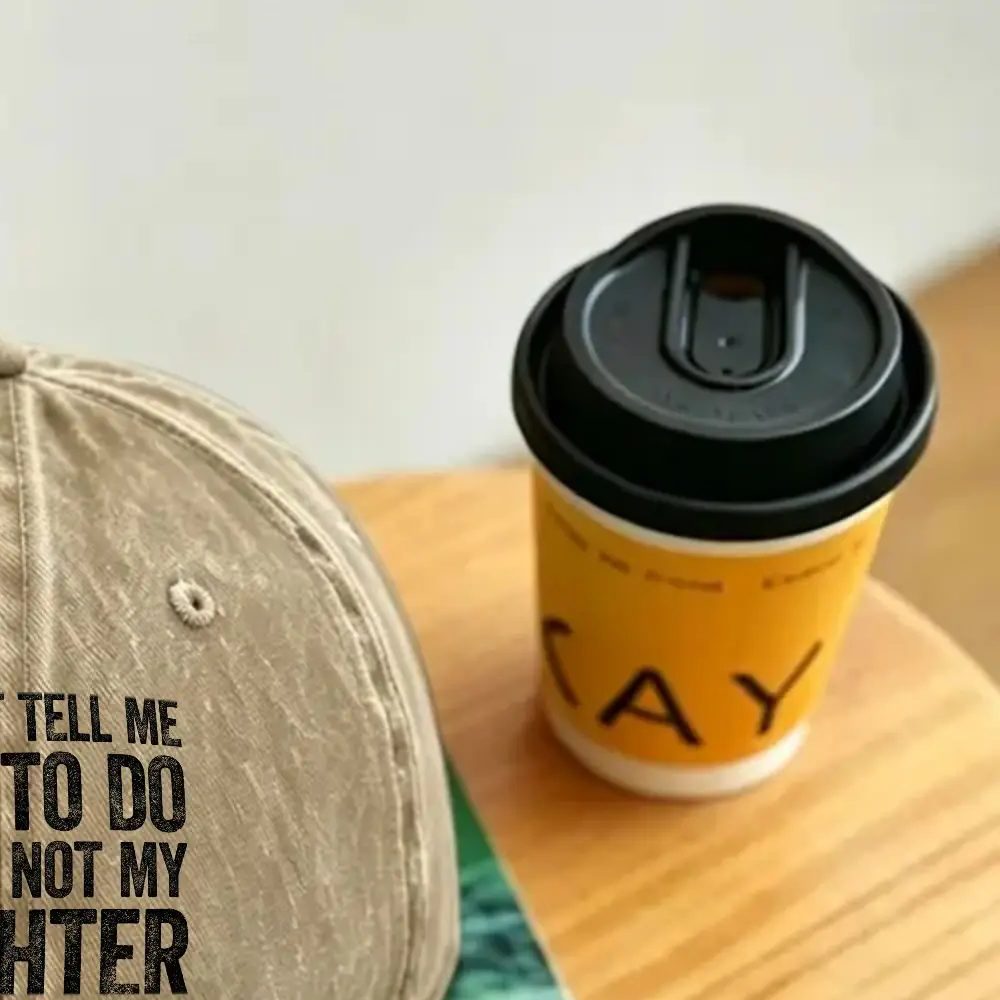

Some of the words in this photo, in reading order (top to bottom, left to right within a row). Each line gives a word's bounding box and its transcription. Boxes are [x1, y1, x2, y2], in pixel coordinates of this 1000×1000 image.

[17, 692, 113, 743] TELL
[124, 697, 182, 748] ME
[0, 751, 82, 832] TO
[107, 753, 187, 833] DO
[11, 841, 103, 899] NOT
[119, 842, 188, 898] MY
